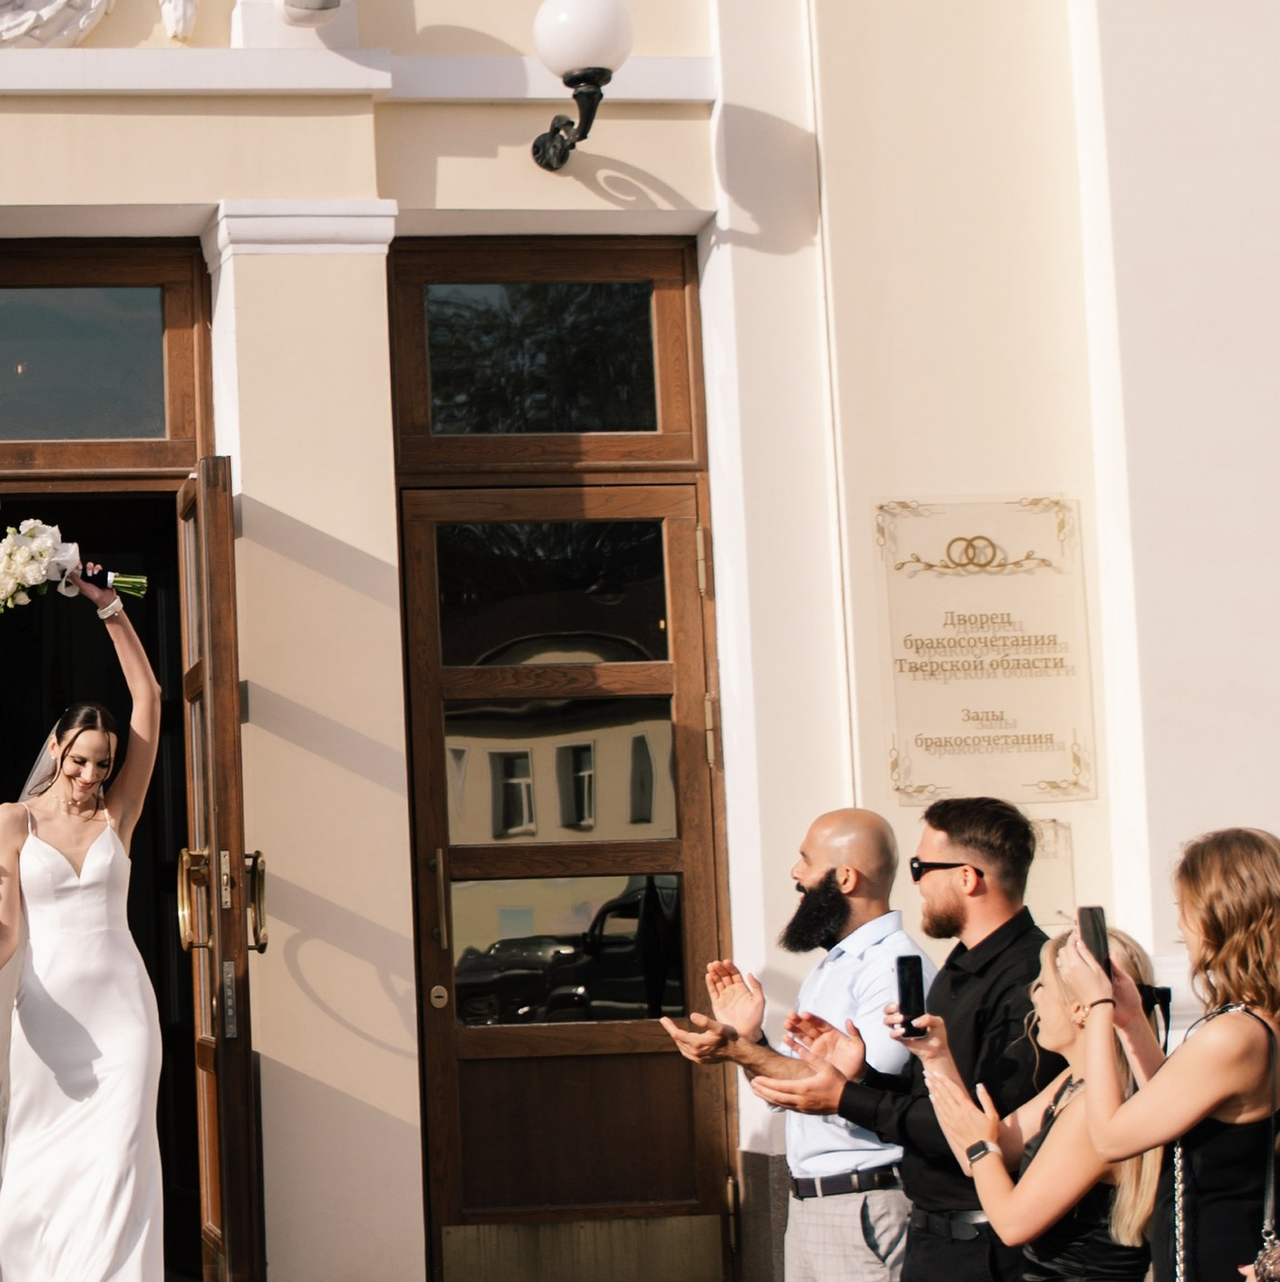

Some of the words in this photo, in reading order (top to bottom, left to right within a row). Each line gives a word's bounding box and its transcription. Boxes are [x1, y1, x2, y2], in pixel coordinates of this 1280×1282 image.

[943, 611, 1012, 628] Дворец
[903, 633, 1059, 653] бракосочетания
[894, 654, 985, 676] Тверской
[989, 653, 1065, 670] области
[961, 708, 1005, 722] Залы
[914, 733, 1055, 751] бракосочетания
